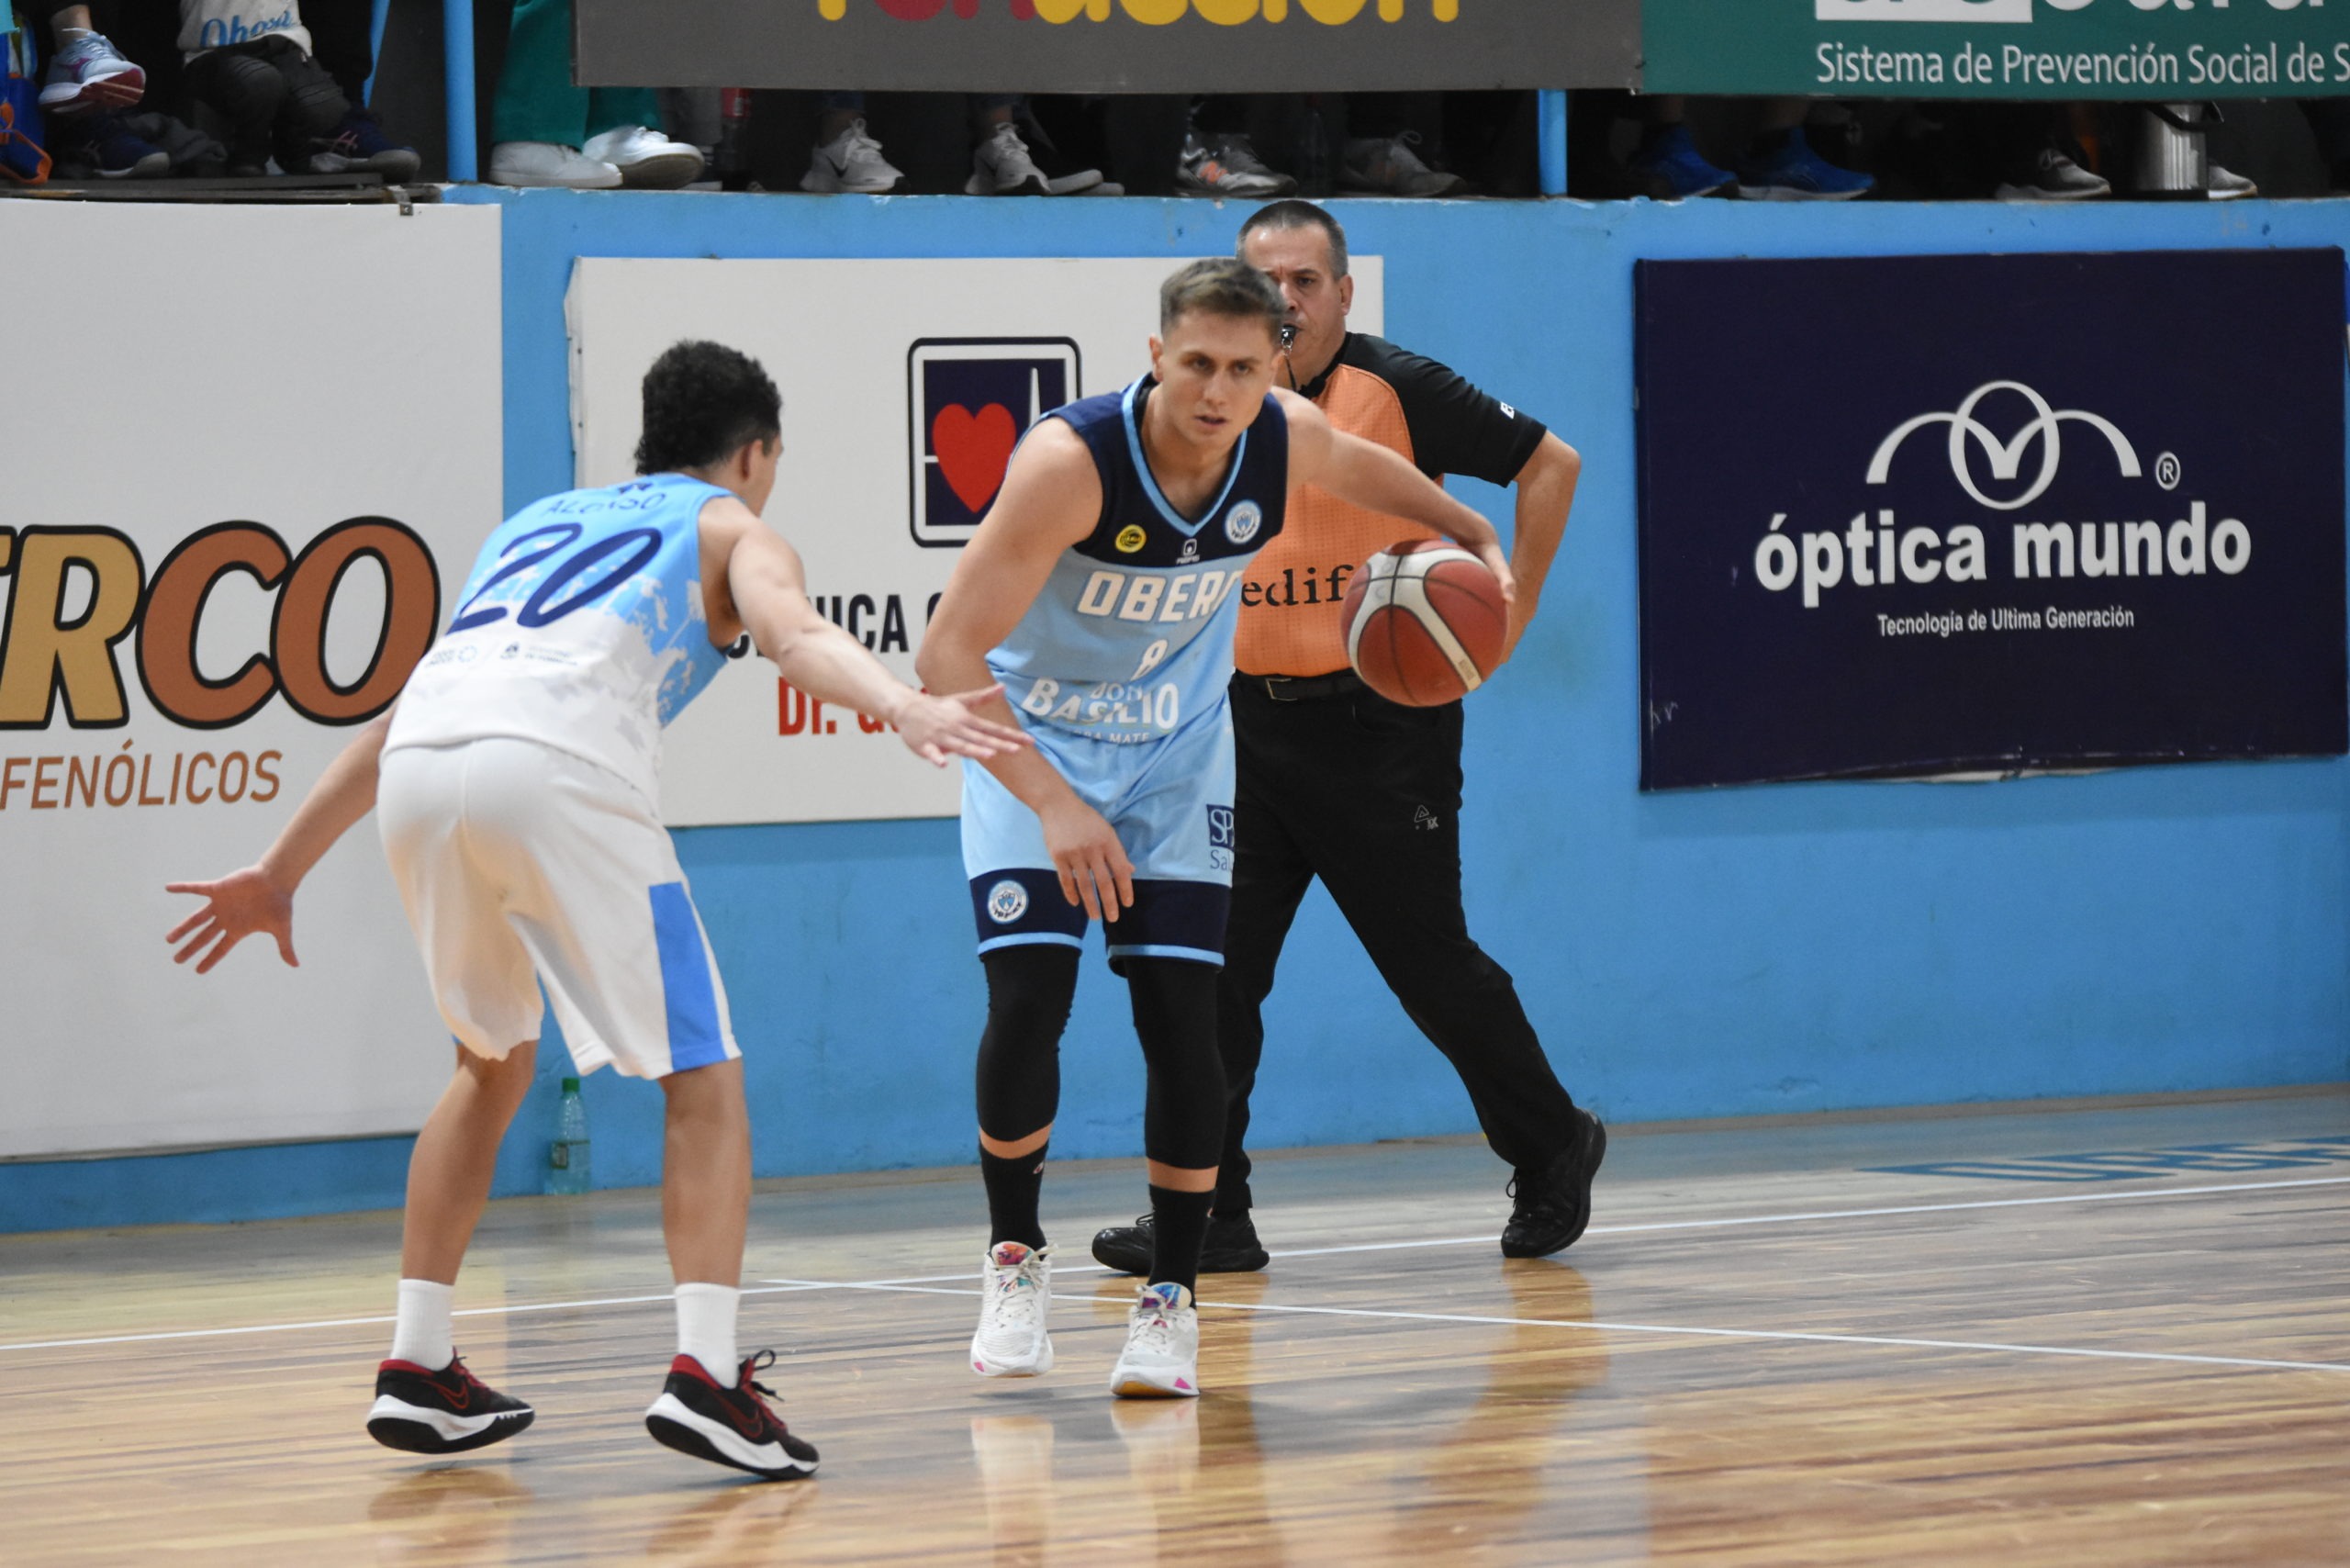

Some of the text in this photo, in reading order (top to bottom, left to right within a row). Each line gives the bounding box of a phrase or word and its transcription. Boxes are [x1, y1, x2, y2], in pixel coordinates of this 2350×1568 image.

[1816, 41, 1944, 84] Sistema
[1953, 40, 1994, 84] de
[2002, 42, 2179, 84] Prevención
[2188, 40, 2277, 84] Social
[2287, 40, 2325, 84] de
[445, 522, 663, 635] 20
[1754, 500, 2252, 608] óptica mundo
[1240, 564, 1354, 608] edif
[0, 515, 442, 731] RCO
[1877, 604, 2135, 638] Tecnología de Ultima Generación
[1021, 677, 1180, 730] BASILIO
[0, 739, 284, 811] FENÓLICOS
